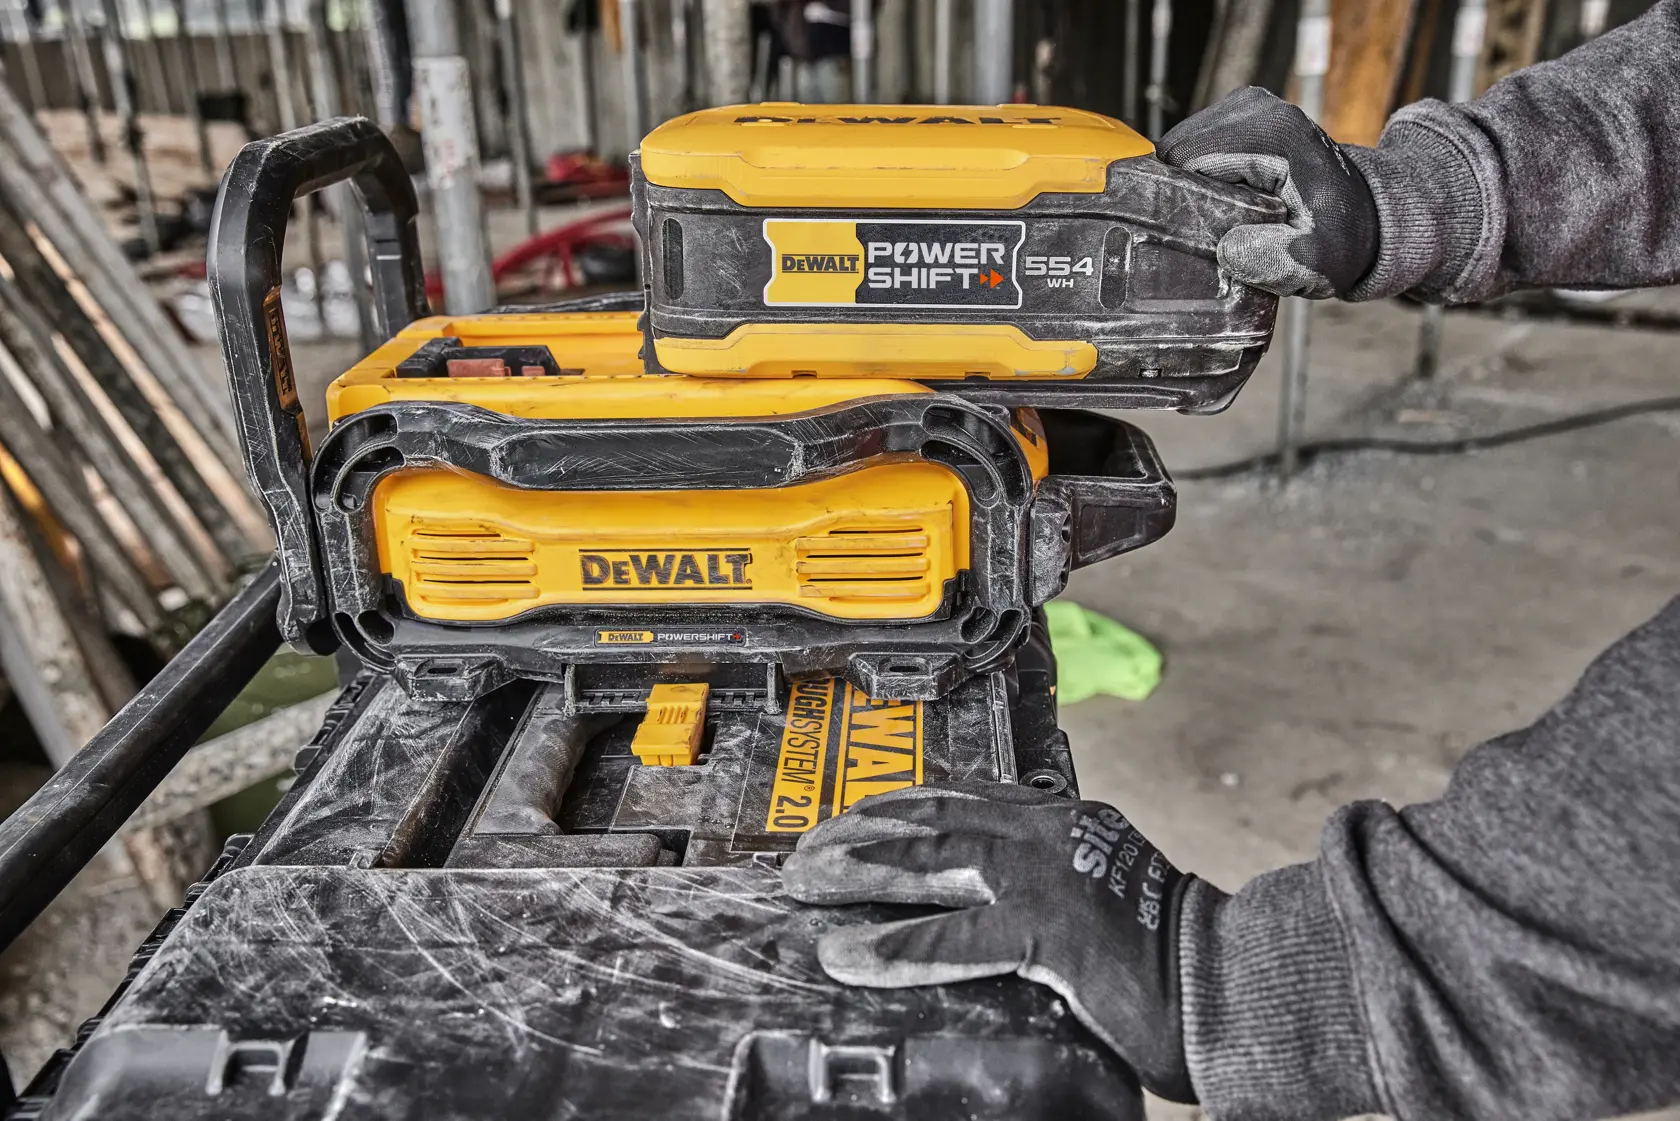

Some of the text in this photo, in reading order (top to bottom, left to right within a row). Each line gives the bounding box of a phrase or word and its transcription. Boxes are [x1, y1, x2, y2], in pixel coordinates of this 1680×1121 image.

[867, 242, 1004, 264] POWER
[1024, 256, 1094, 276] 554
[867, 267, 979, 289] SHIFT
[1047, 278, 1074, 288] WH
[657, 633, 732, 641] POWERSHIFT
[772, 795, 812, 828] 2.0
[1108, 843, 1139, 899] KF120
